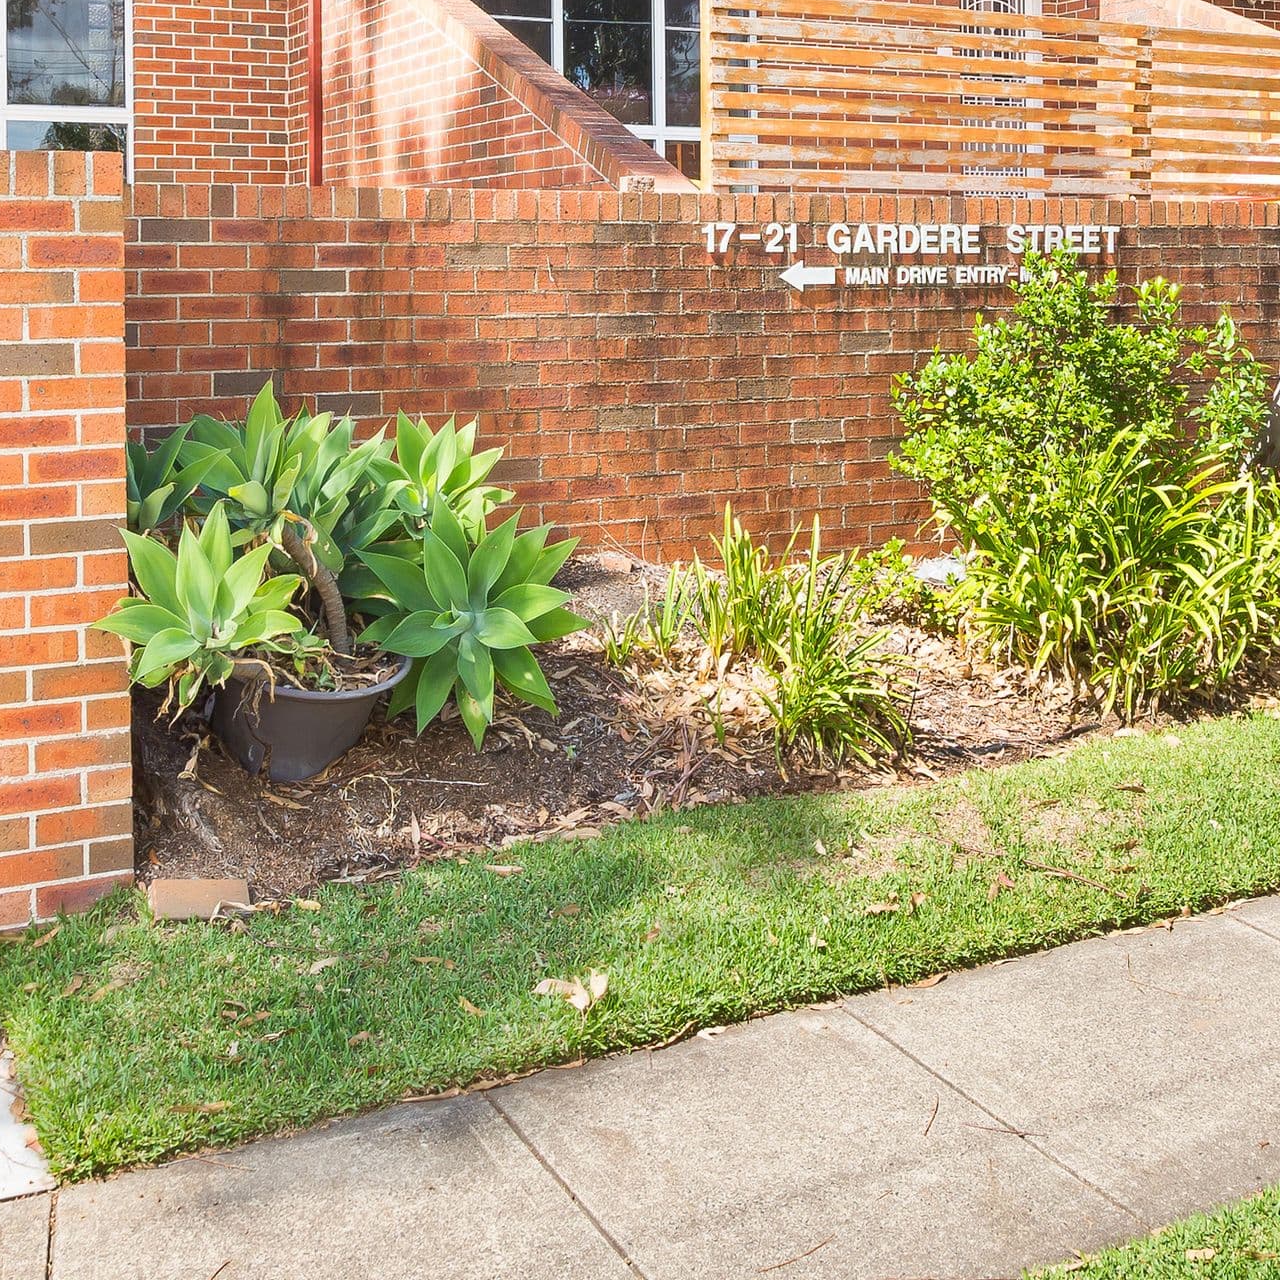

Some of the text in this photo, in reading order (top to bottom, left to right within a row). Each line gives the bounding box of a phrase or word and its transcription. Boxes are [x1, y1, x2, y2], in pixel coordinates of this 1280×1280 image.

[701, 223, 1120, 254] 17-21 GARDERE STREET
[846, 267, 889, 284] MAIN
[896, 266, 948, 284] DRIVE
